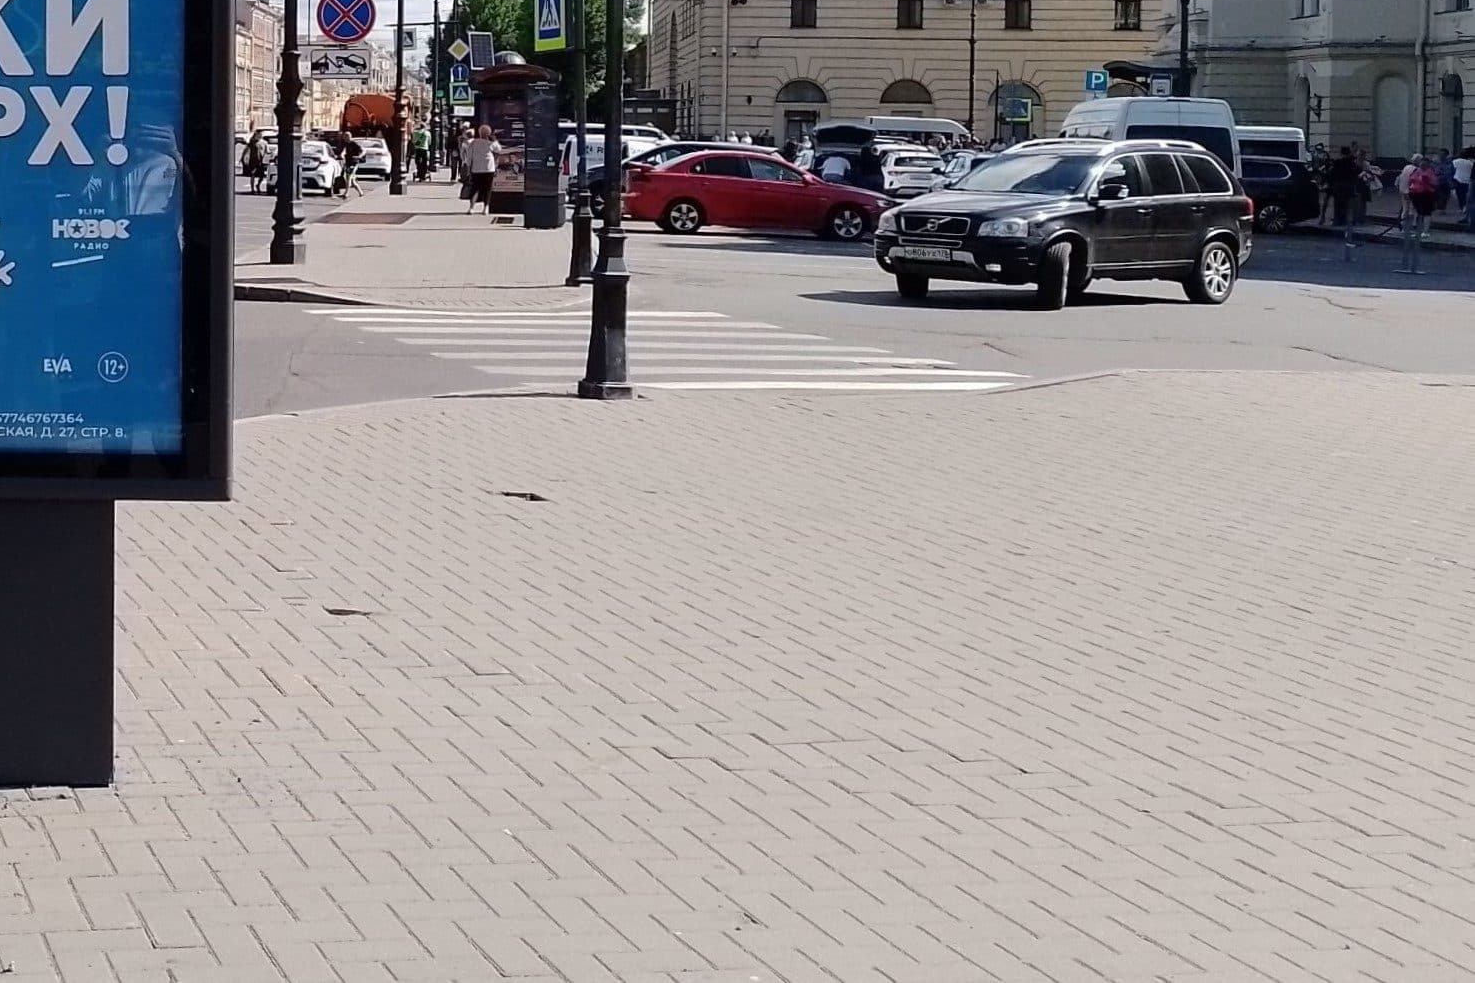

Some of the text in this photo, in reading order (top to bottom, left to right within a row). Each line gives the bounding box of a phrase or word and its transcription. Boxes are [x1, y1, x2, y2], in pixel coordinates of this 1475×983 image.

[104, 359, 125, 375] 12+
[41, 427, 55, 438] Д.
[59, 428, 77, 438] 27,
[81, 428, 111, 438] СТР.
